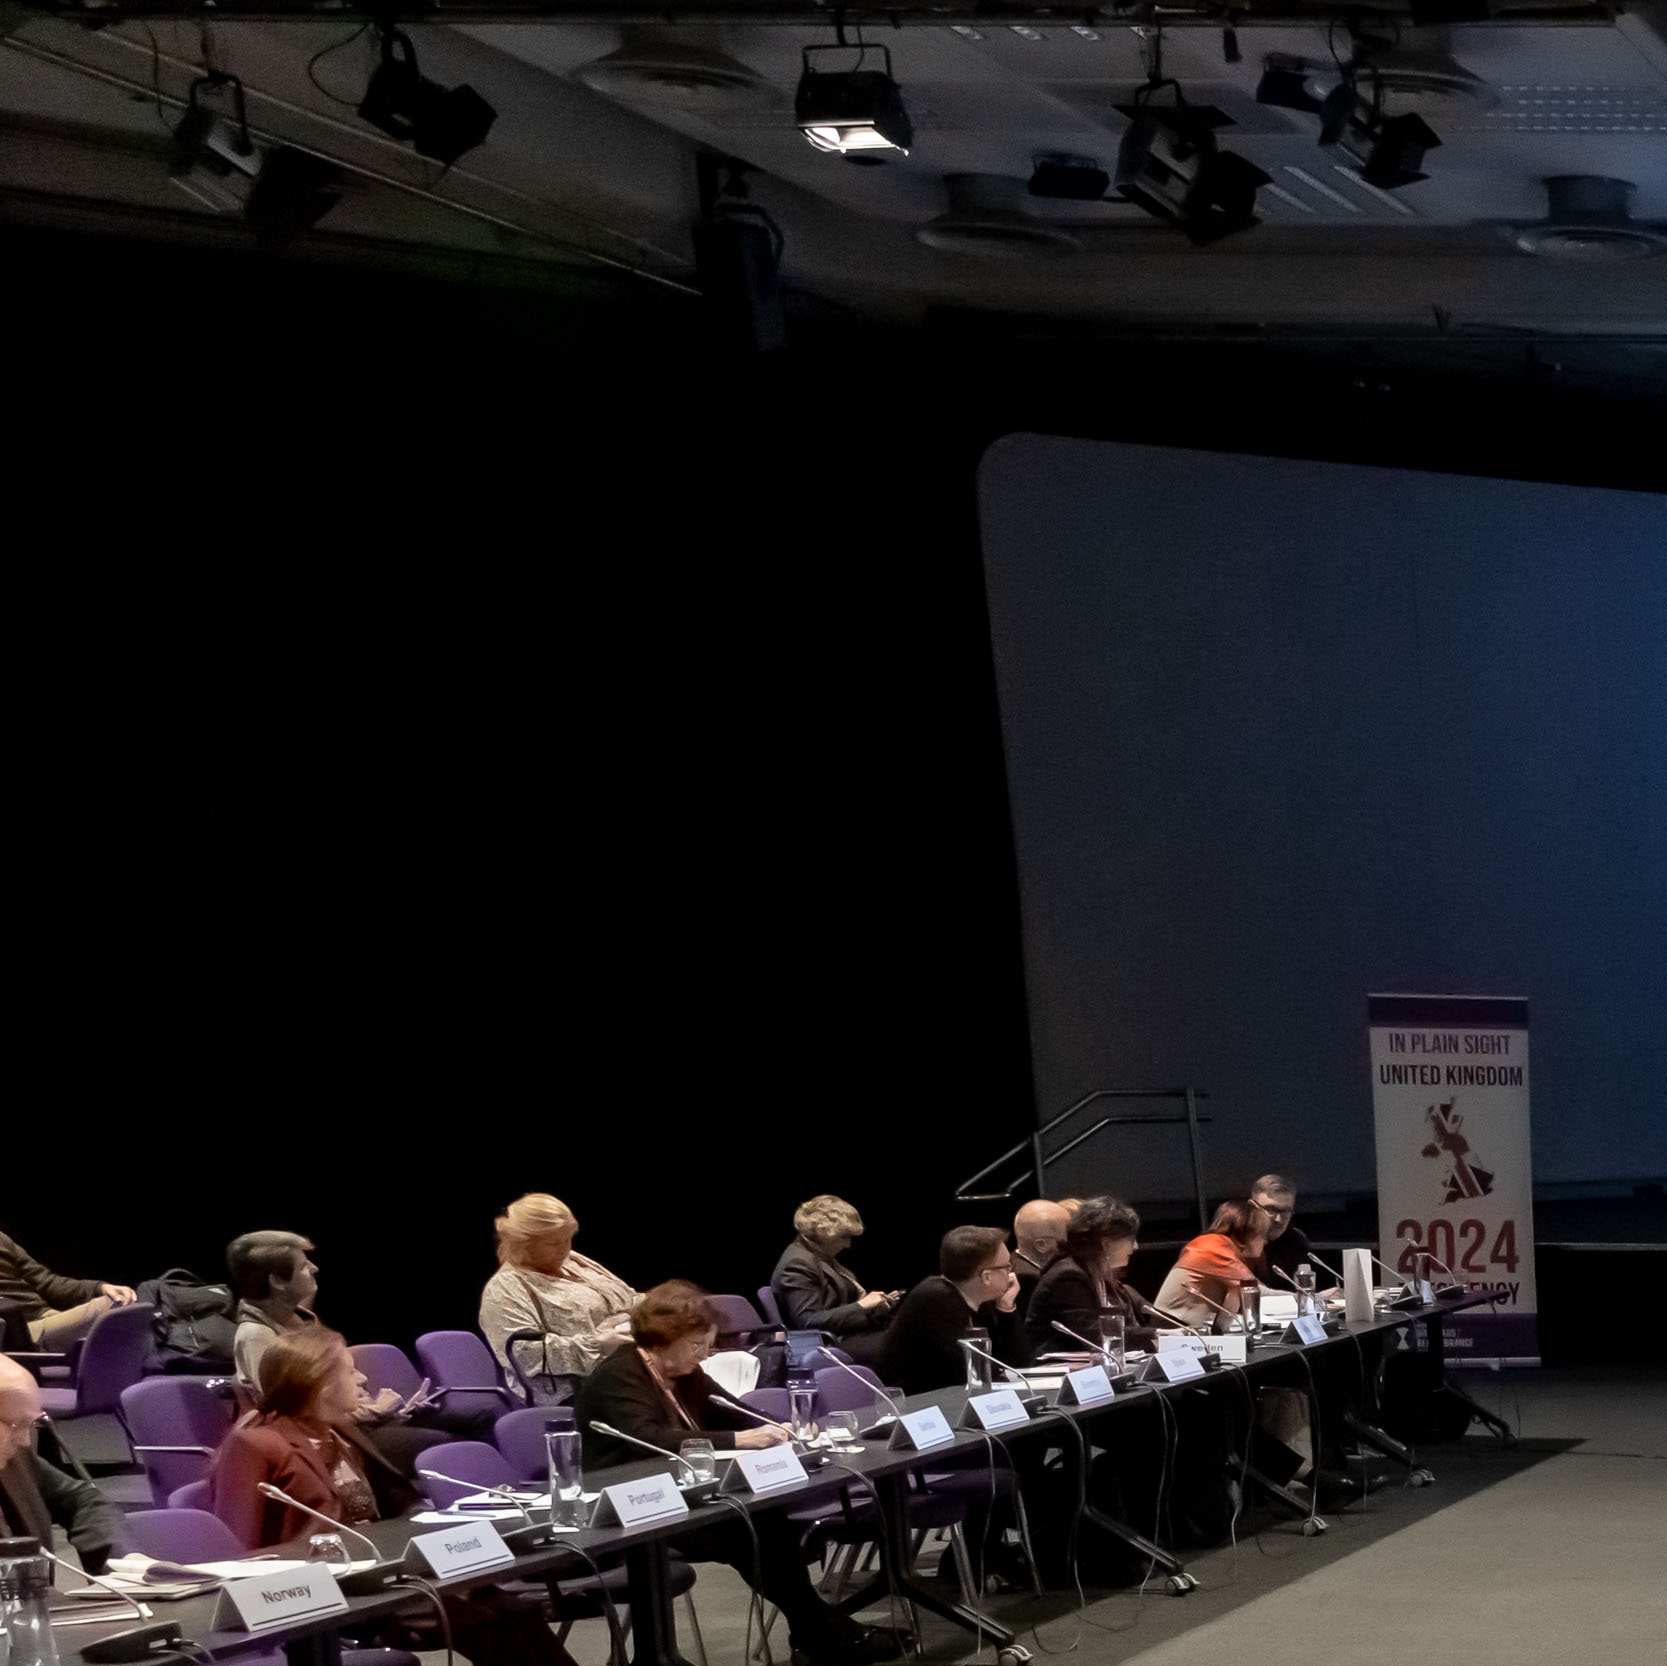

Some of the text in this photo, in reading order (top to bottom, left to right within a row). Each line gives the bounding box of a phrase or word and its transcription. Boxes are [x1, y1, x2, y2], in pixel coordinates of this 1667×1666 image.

[1389, 1033, 1511, 1054] IN PLAIN SIGHT
[1380, 1064, 1523, 1086] UNITED KINGDOM
[1396, 1219, 1519, 1273] 2024
[445, 1537, 482, 1553] Poland
[261, 1585, 311, 1603] Norway
